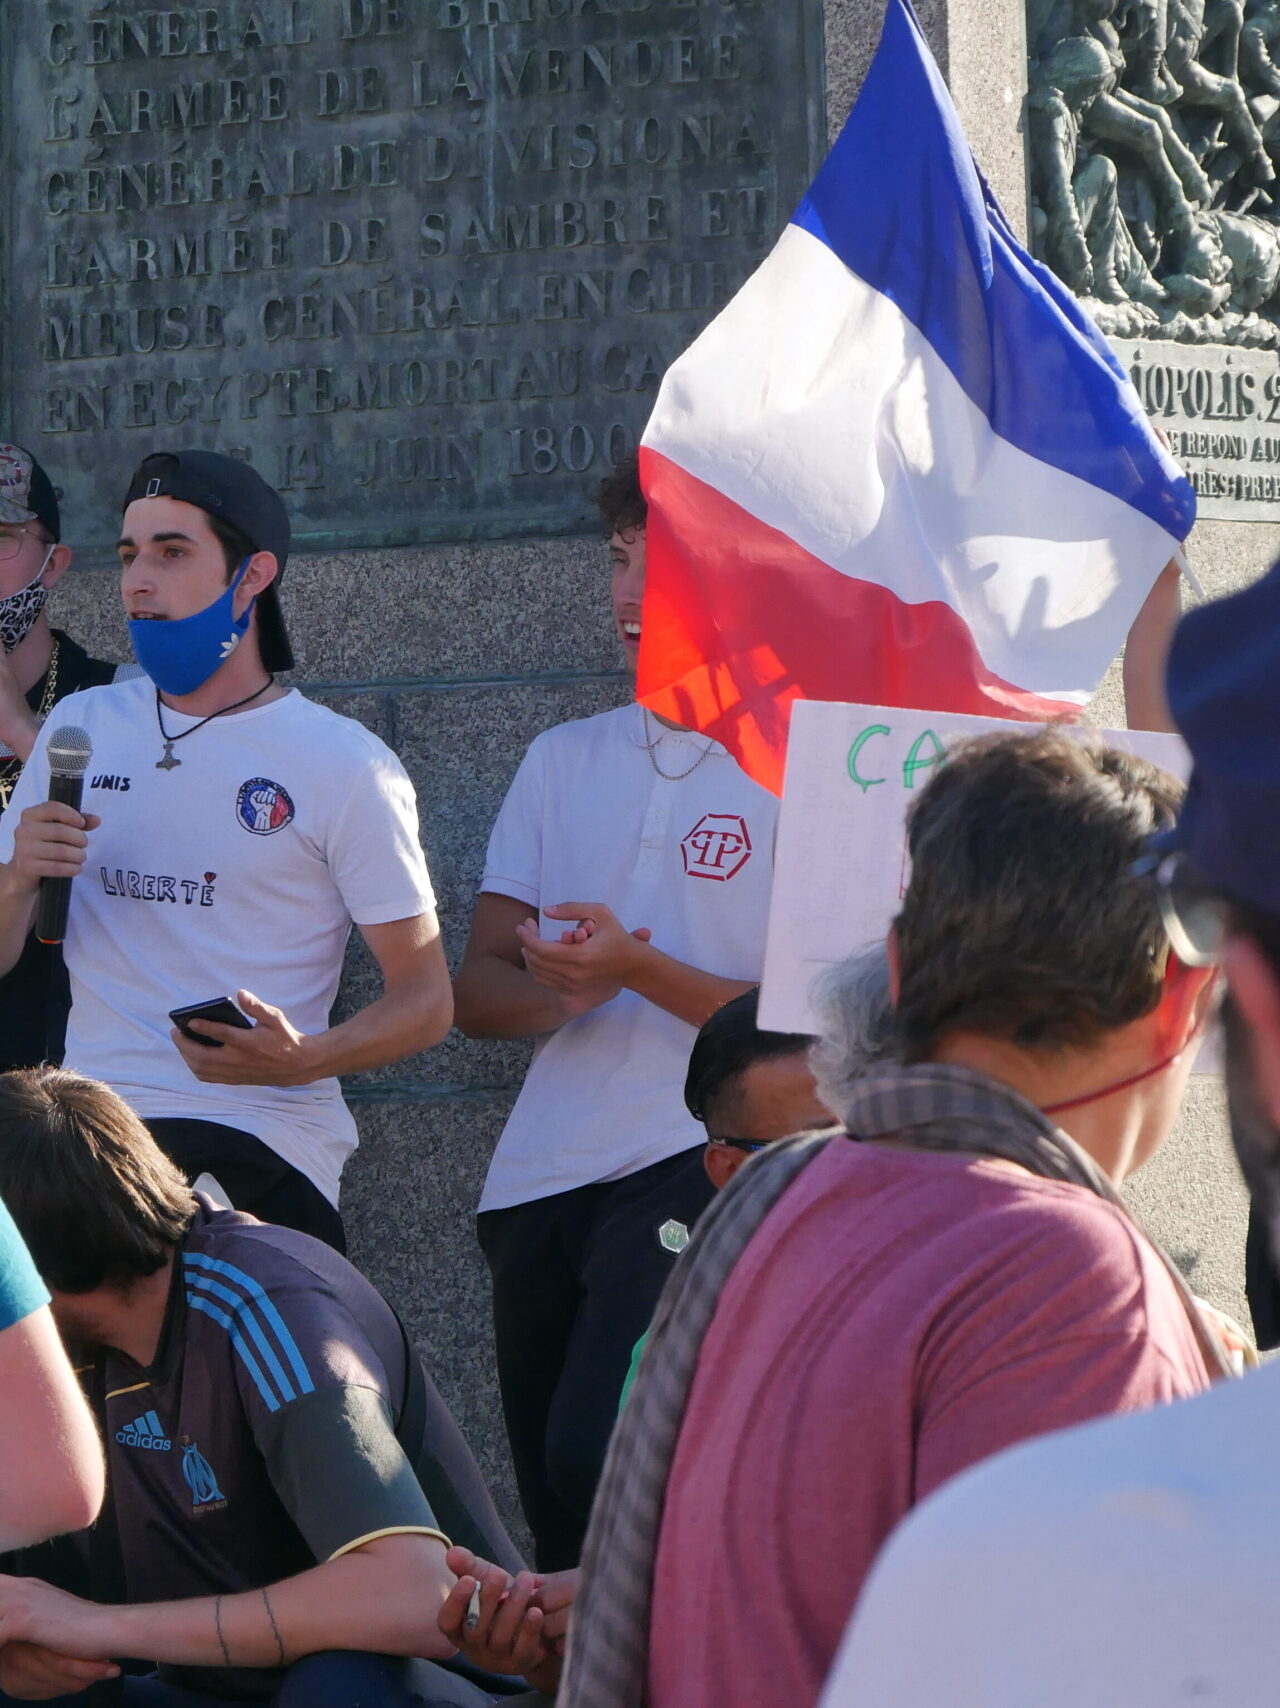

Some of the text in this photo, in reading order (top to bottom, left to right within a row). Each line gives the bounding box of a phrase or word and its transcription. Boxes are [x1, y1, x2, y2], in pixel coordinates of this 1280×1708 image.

[340, 0, 408, 39] DE
[316, 64, 385, 117] DE
[329, 139, 398, 192] DE
[321, 217, 388, 267] DE
[419, 194, 670, 259] SAMBRE
[698, 183, 767, 239] ET
[355, 420, 480, 485] JUIN
[90, 774, 131, 792] UNIS
[115, 1431, 172, 1451] adidas
